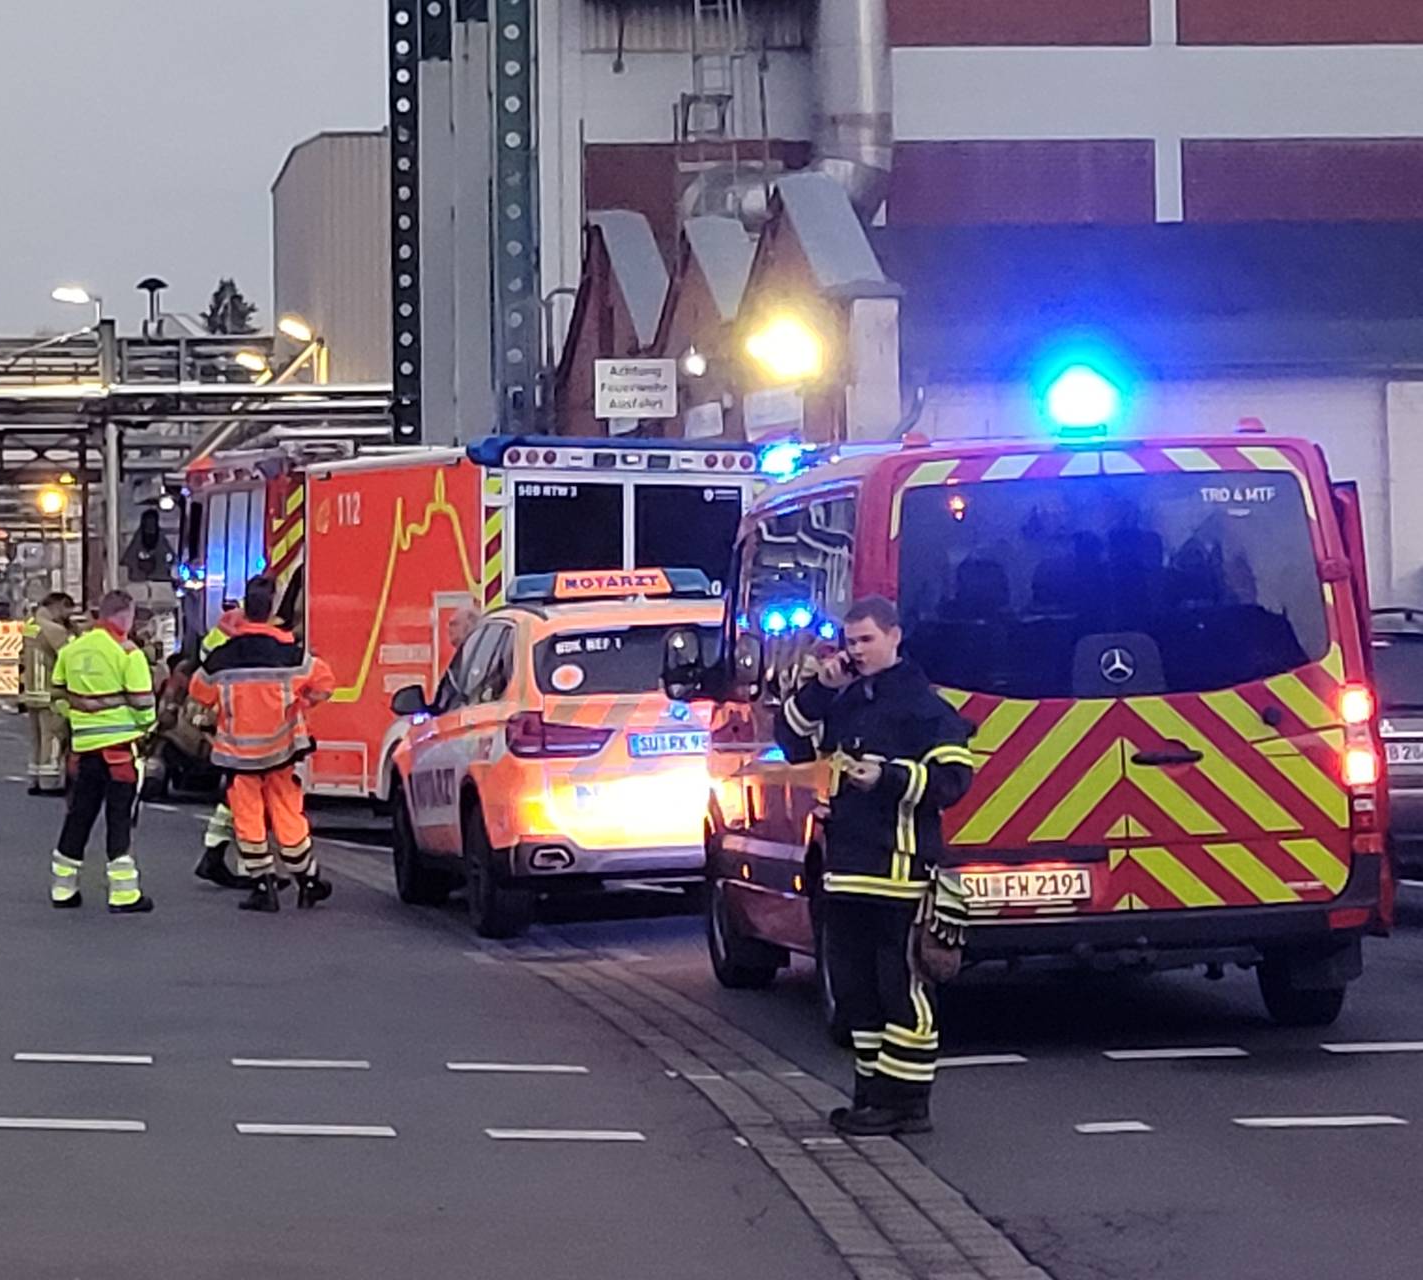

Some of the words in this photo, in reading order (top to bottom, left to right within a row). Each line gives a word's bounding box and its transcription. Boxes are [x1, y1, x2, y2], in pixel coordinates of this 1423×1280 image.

[609, 366, 662, 378] Achtung
[600, 382, 667, 393] Feuerwehr
[1245, 485, 1276, 502] MTF
[338, 491, 361, 526] 112
[564, 574, 659, 590] NOTARZT
[640, 736, 658, 751] SU
[962, 876, 989, 898] SU
[1004, 875, 1030, 897] FW
[1035, 873, 1088, 896] 2191
